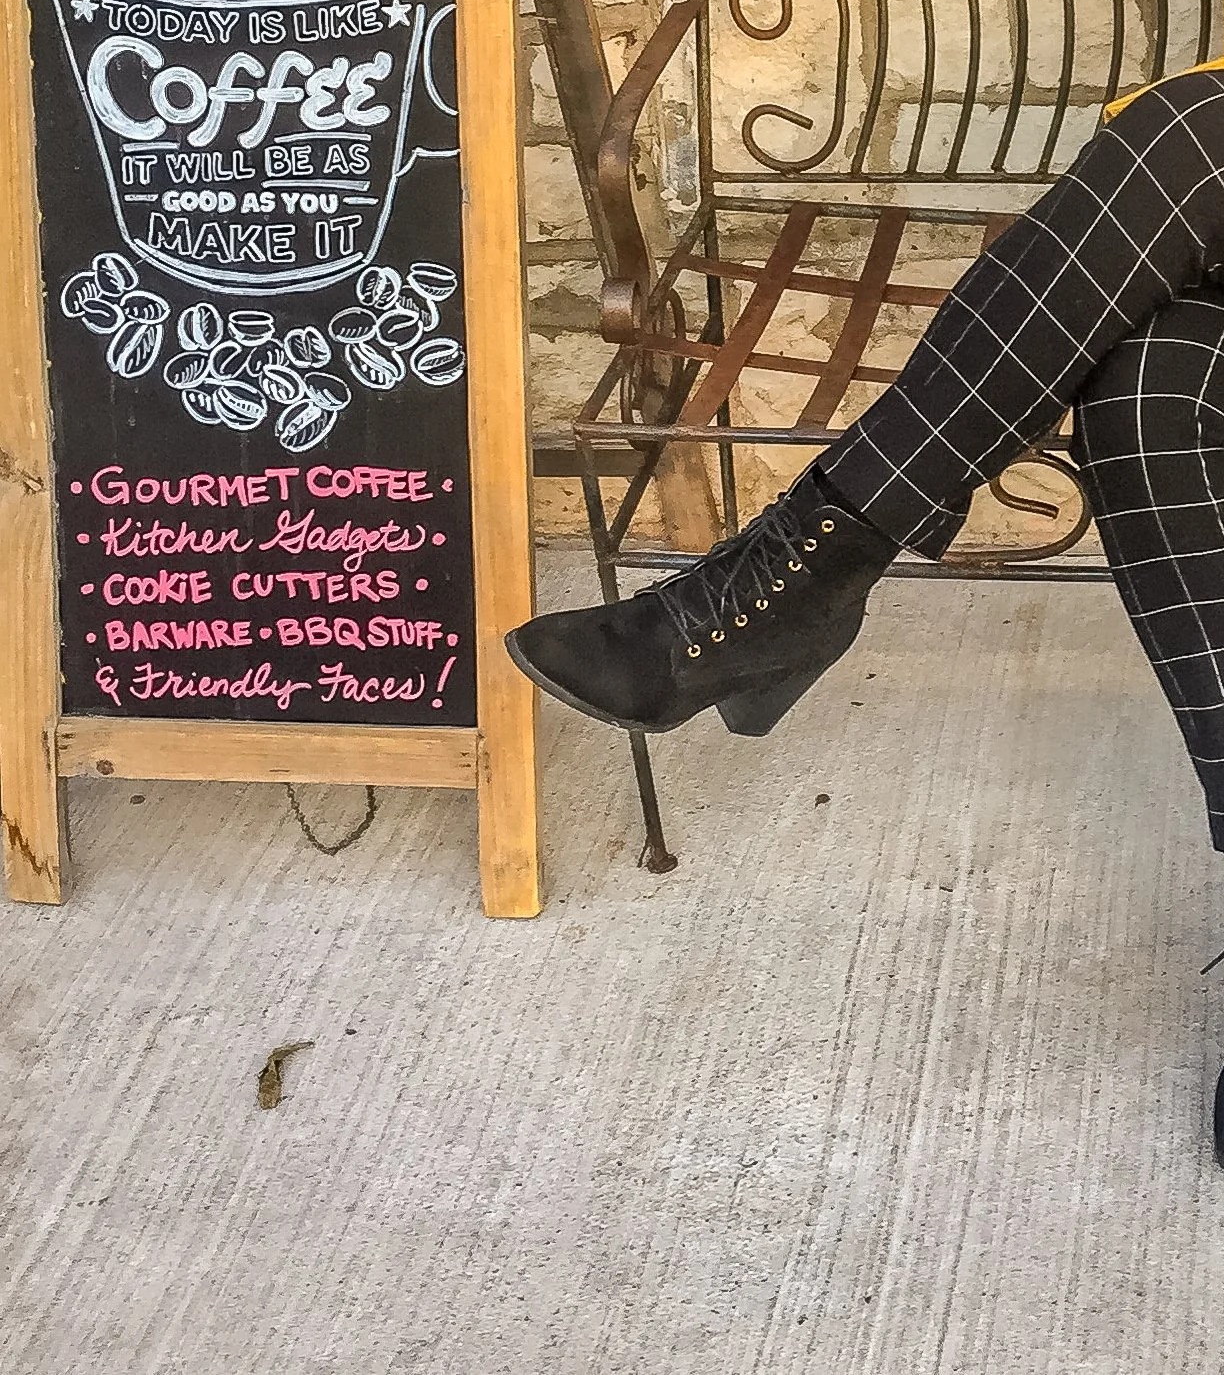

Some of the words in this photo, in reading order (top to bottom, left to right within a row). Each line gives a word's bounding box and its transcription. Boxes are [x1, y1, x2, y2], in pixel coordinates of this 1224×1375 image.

[248, 11, 289, 44] IS
[121, 154, 159, 186] IT
[165, 153, 256, 184] WILL
[264, 143, 315, 178] BE
[323, 143, 372, 176] AS
[160, 189, 238, 215] GOOD
[240, 191, 277, 214] AS
[280, 191, 340, 215] YOU
[146, 210, 297, 265] MAKE
[313, 213, 365, 261] IT
[90, 464, 300, 508] GOURMET
[305, 464, 435, 502] COFFEE
[100, 516, 253, 558] Kitchen
[258, 508, 426, 574] Gadgets
[231, 570, 401, 604] CUTTERS
[105, 620, 253, 652] BARWARE
[276, 617, 366, 651] BBQ
[366, 615, 444, 649] STUFF
[95, 664, 122, 706] &
[129, 661, 312, 710] Friendly
[317, 656, 457, 709] Faces!
